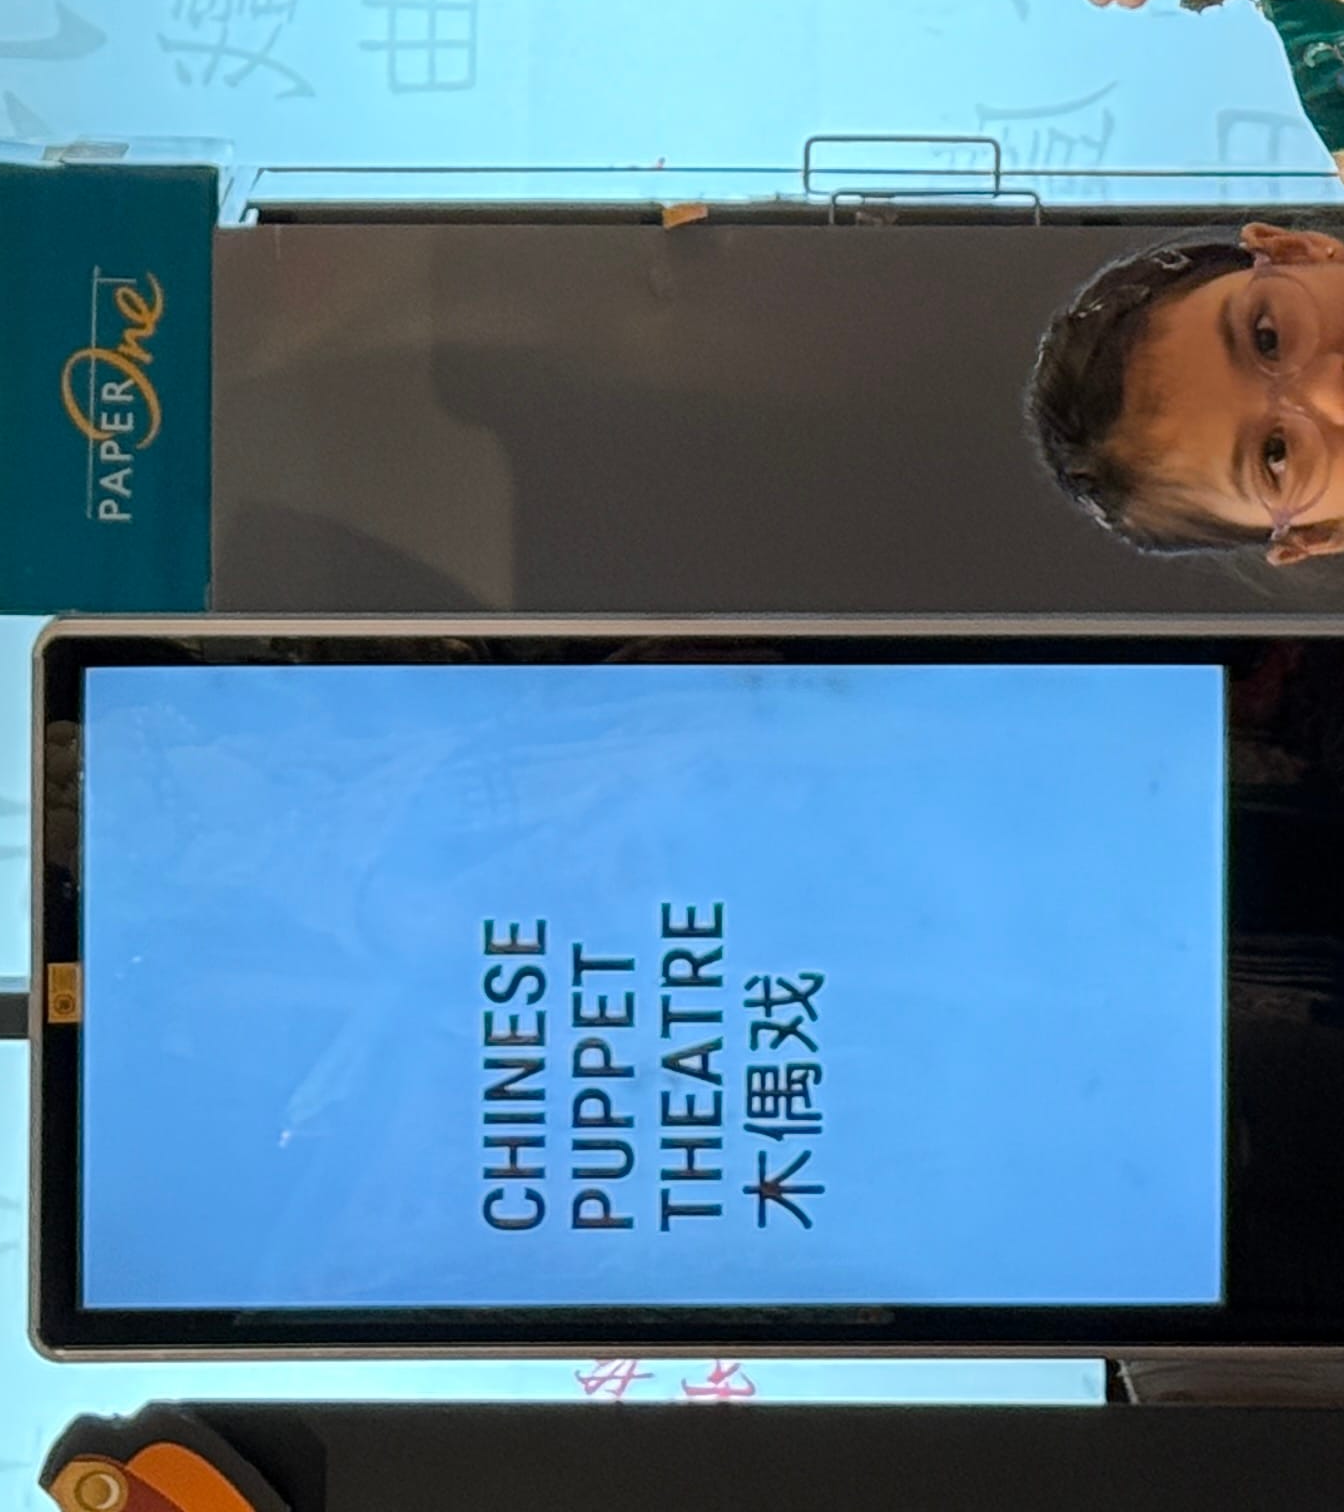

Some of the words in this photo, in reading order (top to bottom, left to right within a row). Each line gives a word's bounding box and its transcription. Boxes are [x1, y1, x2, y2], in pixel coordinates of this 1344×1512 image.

[481, 916, 547, 1233] CHINESE
[570, 943, 636, 1233] PUPPET
[659, 901, 725, 1232] THEATRE
[742, 970, 825, 1231] 木偶戏
